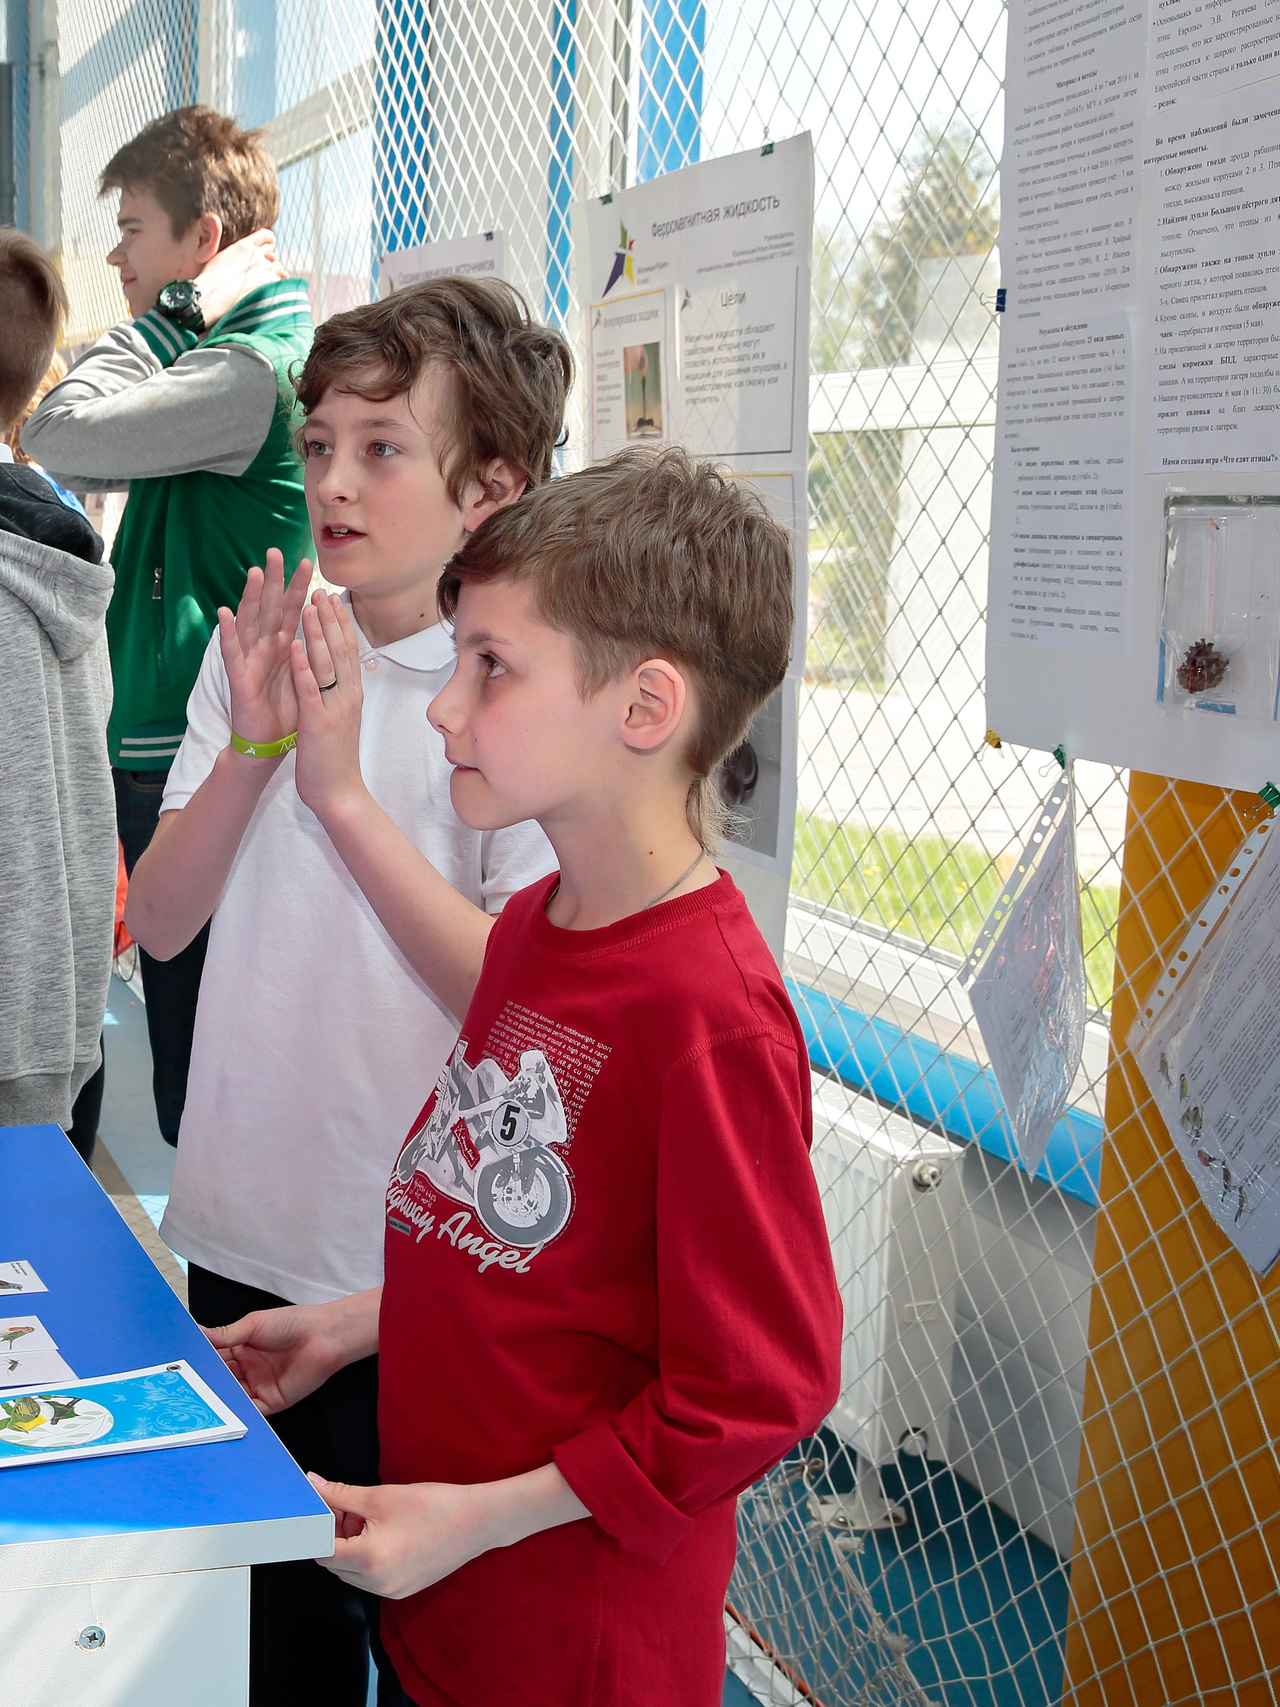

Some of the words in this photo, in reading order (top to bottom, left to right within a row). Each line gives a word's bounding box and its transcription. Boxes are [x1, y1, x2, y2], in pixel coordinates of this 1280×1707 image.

[1191, 40, 1202, 49] что
[1203, 36, 1213, 45] все
[1213, 46, 1237, 59] широко
[1154, 75, 1191, 94] Европейской
[1191, 72, 1209, 82] части
[1208, 65, 1230, 78] страны
[1236, 57, 1257, 70] только
[1257, 52, 1273, 62] один
[1167, 133, 1186, 145] время
[1190, 120, 1228, 138] наблюдений
[1231, 117, 1249, 127] были
[1143, 152, 1178, 166] интересные
[1178, 144, 1209, 157] моменты.
[1206, 157, 1227, 167] гнездо
[1229, 151, 1250, 163] дрозда
[1164, 183, 1182, 193] между
[1185, 177, 1211, 188] жилыми
[1212, 169, 1243, 183] корпусами
[722, 195, 781, 220] жидкость
[1189, 211, 1209, 222] дупло
[1210, 204, 1241, 217] Большого
[1241, 198, 1269, 210] пёстрого
[1187, 226, 1220, 237] Отмечено,
[1224, 222, 1235, 231] что
[1238, 217, 1260, 228] птенцы
[1201, 259, 1221, 268] также
[1234, 253, 1255, 263] тополе
[1256, 249, 1276, 260] дупло
[1158, 281, 1182, 292] черного
[1209, 271, 1234, 284] которой
[1234, 268, 1264, 279] появились
[721, 291, 747, 308] Цели
[1170, 296, 1189, 305] Самец
[1189, 292, 1218, 304] прилетал
[1218, 289, 1244, 300] кормить
[1243, 285, 1268, 295] птенцов.
[1179, 311, 1199, 320] скопы,
[1208, 307, 1233, 317] воздухе
[1234, 304, 1250, 313] были
[1159, 331, 1174, 339] чаек
[1178, 326, 1214, 338] серебристая
[1219, 322, 1243, 333] озерная
[1167, 342, 1207, 356] прилегающей
[1213, 340, 1236, 350] лагерю
[1236, 336, 1270, 348] территории
[1158, 363, 1177, 371] следы
[1182, 359, 1214, 370] кормежки
[1243, 352, 1279, 364] характерные
[1194, 374, 1229, 385] территории
[1229, 372, 1249, 382] лагеря
[1179, 391, 1224, 403] руководителем
[1157, 411, 1179, 420] прилет
[1185, 408, 1211, 417] соловья
[1232, 404, 1247, 414] близ
[1156, 426, 1191, 436] территорию
[1191, 425, 1210, 435] рядом
[1214, 423, 1239, 432] лагерем.
[1162, 457, 1180, 466] Нами
[1205, 457, 1219, 466] игра
[1219, 455, 1235, 464] «Что
[1250, 453, 1279, 463] птицы?»
[593, 1050, 609, 1060] race
[596, 1042, 613, 1054] sport
[582, 1063, 601, 1075] sized
[572, 1092, 587, 1103] how
[575, 1087, 590, 1097] and
[500, 1105, 521, 1141] 5
[436, 1211, 546, 1274] Angel
